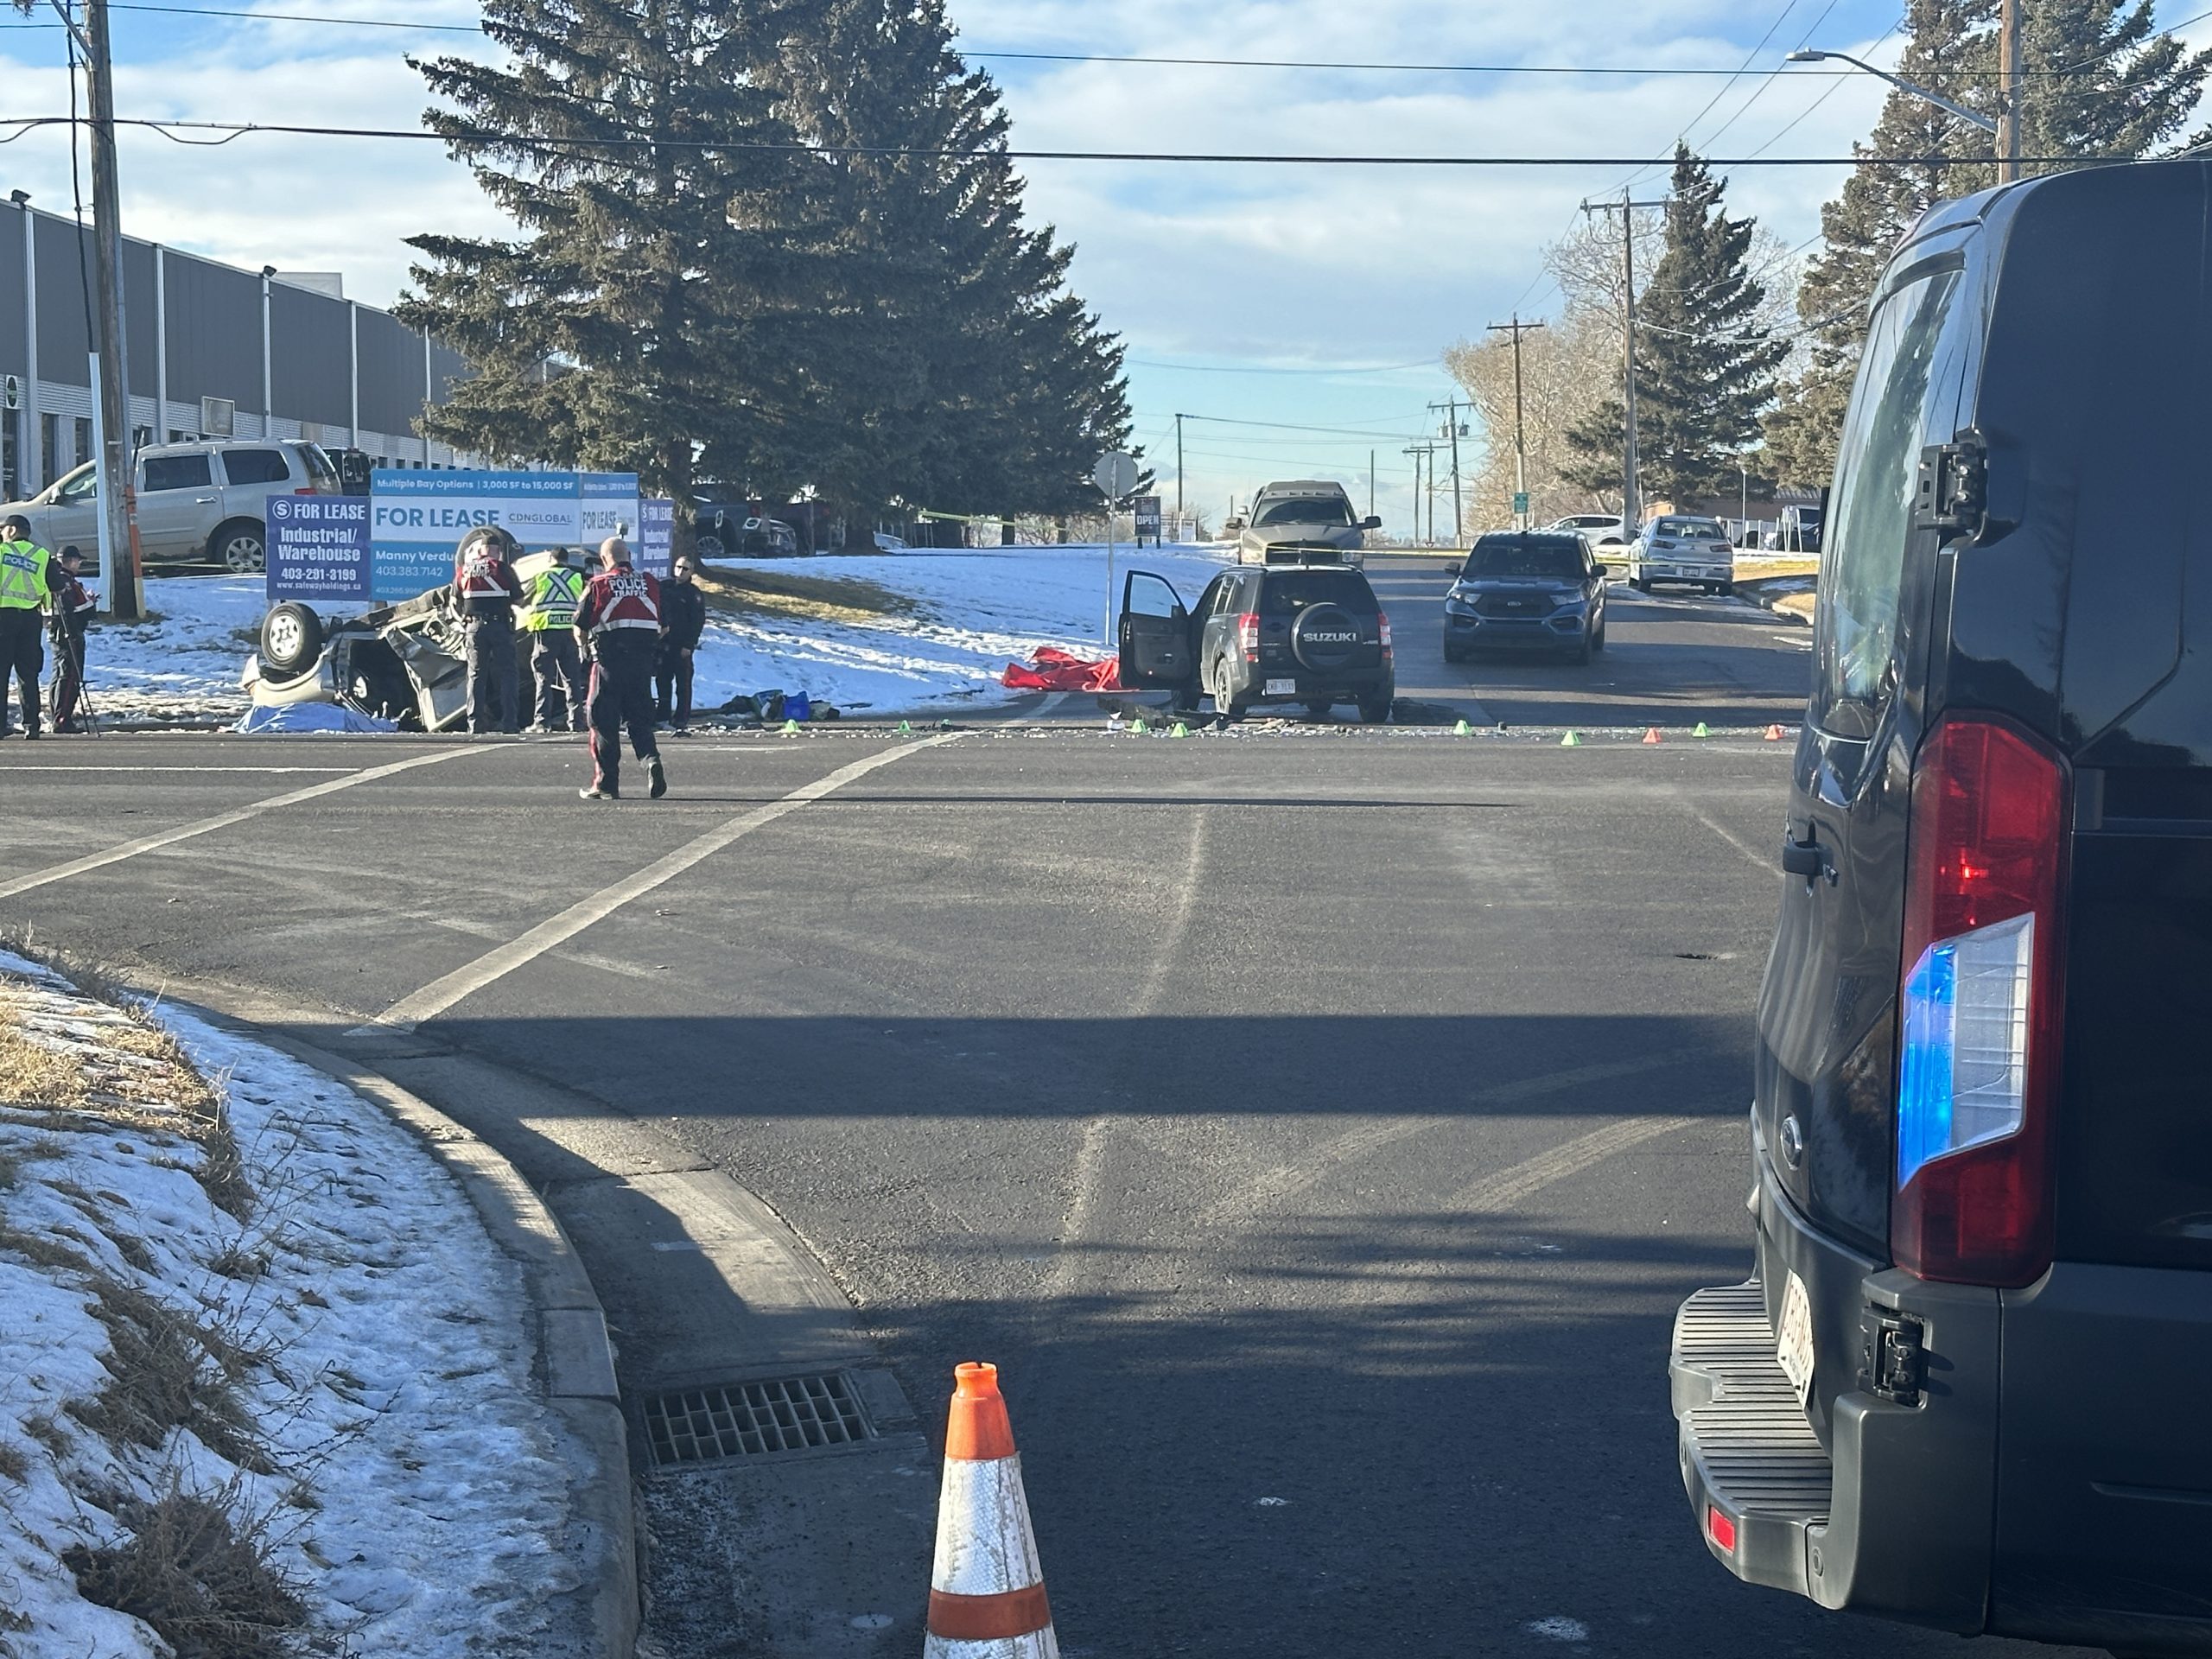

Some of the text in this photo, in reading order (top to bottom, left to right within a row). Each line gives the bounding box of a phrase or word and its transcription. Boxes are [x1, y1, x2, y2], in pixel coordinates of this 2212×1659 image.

[377, 479, 415, 490] Multiple
[416, 480, 435, 490] Bay
[436, 480, 474, 490] Options
[482, 480, 508, 490] 3,000
[532, 481, 562, 491] 15,000
[294, 504, 320, 518] FOR
[324, 504, 365, 519] LEASE
[376, 507, 500, 528] FOR LEASE
[508, 513, 573, 524] CDNGLOBAL
[582, 511, 596, 529] FOR
[597, 511, 617, 529] LEASE
[1136, 515, 1160, 525] OPEN
[281, 526, 358, 544] Industrial/
[277, 544, 361, 562] Warehouse
[375, 550, 416, 563] Manny
[4, 555, 38, 571] POLICE
[375, 566, 443, 577] 403.383.7142
[608, 578, 648, 591] POLICE
[613, 589, 647, 598] TRAFFIC
[549, 614, 571, 624] POLIC
[1303, 632, 1357, 643] SUZUKI
